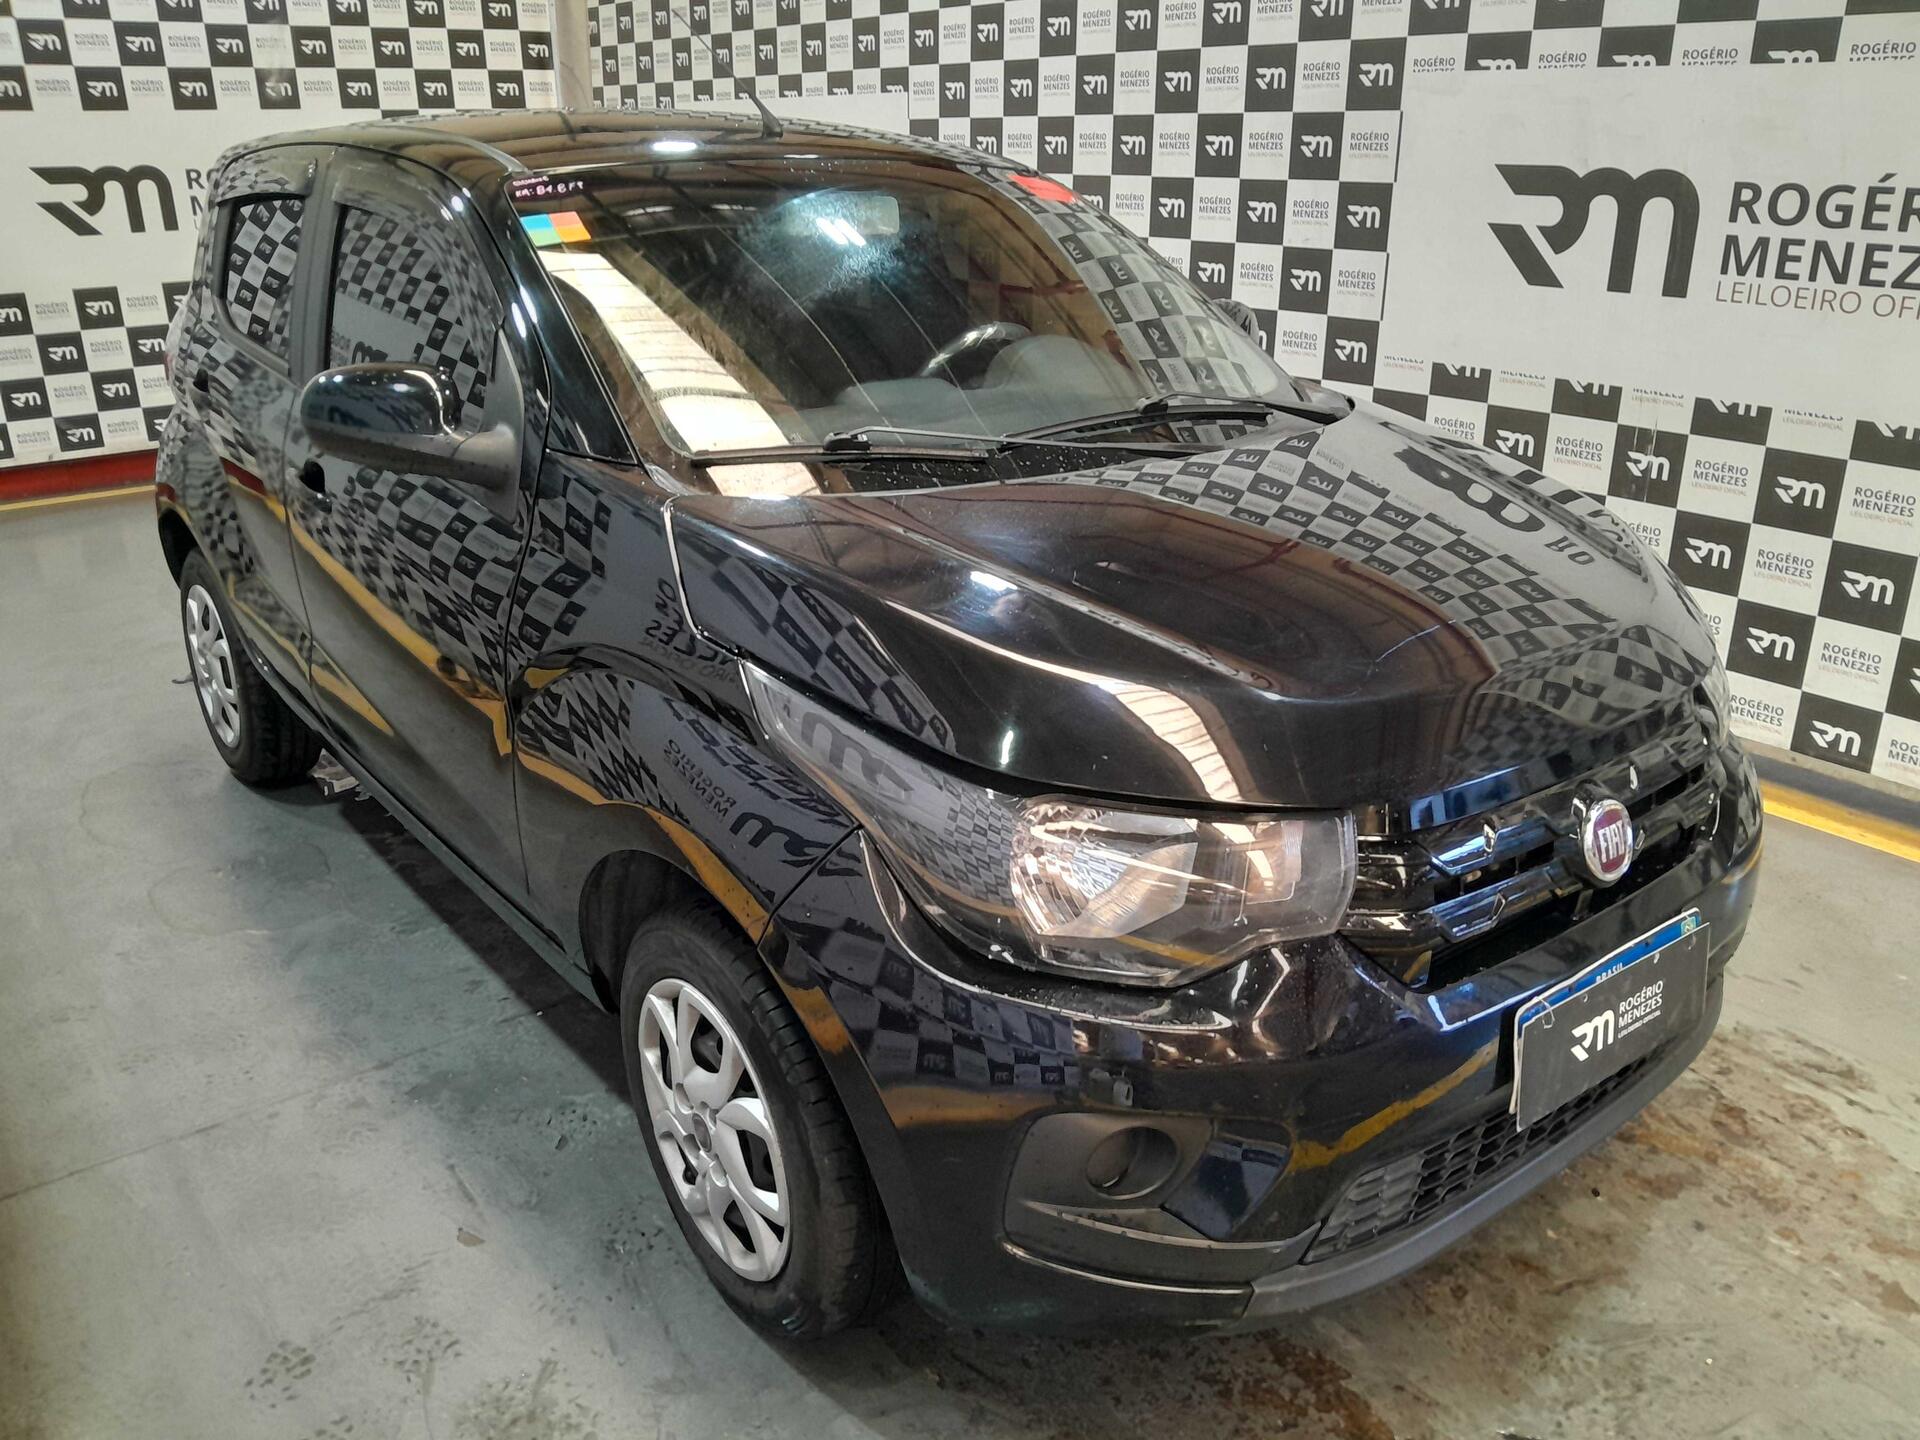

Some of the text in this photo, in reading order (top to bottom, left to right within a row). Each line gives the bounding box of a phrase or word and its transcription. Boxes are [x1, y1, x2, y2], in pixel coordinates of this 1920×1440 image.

[1165, 1, 1196, 12] ROGÉRIO
[1165, 11, 1196, 21] MENEZES
[1682, 46, 1738, 61] ROGÉRIO
[1850, 40, 1916, 56] ROGÉRIO
[1412, 56, 1456, 68] ROGÉRIO
[1538, 52, 1587, 64] ROGÉRIO
[1206, 65, 1239, 75] ROGÉRIO
[1303, 61, 1340, 72] ROGÉRIO
[1206, 74, 1239, 84] MENEZES
[1302, 70, 1340, 81] MENEZES
[1159, 132, 1190, 141] ROGÉRIO
[1249, 131, 1284, 141] ROGÉRIO
[1351, 131, 1390, 141] ROGÉRIO
[1159, 140, 1189, 149] MENEZES
[1249, 140, 1283, 150] MENEZES
[1350, 140, 1389, 152] MENEZES
[1200, 196, 1231, 205] ROGÉRIO
[1293, 199, 1329, 210] ROGÉRIO
[1199, 205, 1231, 214] MENEZES
[1292, 209, 1328, 219] MENEZES
[1240, 262, 1274, 272] ROGÉRIO
[1240, 271, 1273, 282] MENEZES
[1338, 269, 1376, 280] ROGÉRIO
[1337, 279, 1376, 290] MENEZES
[1715, 280, 1861, 313] LEILOEIRO
[1283, 330, 1317, 341] ROGÉRIO
[1282, 339, 1317, 351] MENEZES
[1434, 417, 1476, 430] ROGÉRIO
[1556, 436, 1603, 451] ROGÉRIO
[1555, 447, 1602, 462] MENEZES
[1695, 459, 1749, 476] ROGÉRIO
[1693, 470, 1747, 488] MENEZES
[1854, 486, 1916, 506] ROGÉRIO
[1852, 498, 1914, 518] MENEZES
[1758, 548, 1814, 568] ROGÉRIO
[1756, 560, 1812, 580] MENEZES
[1823, 642, 1882, 664] ROGÉRIO
[1820, 652, 1880, 675] MENEZES
[1731, 694, 1784, 716] ROGÉRIO
[1730, 705, 1782, 727] MENEZES
[1597, 820, 1625, 863] FIAT
[1619, 980, 1663, 1014] ROGÉRIO
[1618, 994, 1662, 1028] MENEZES
